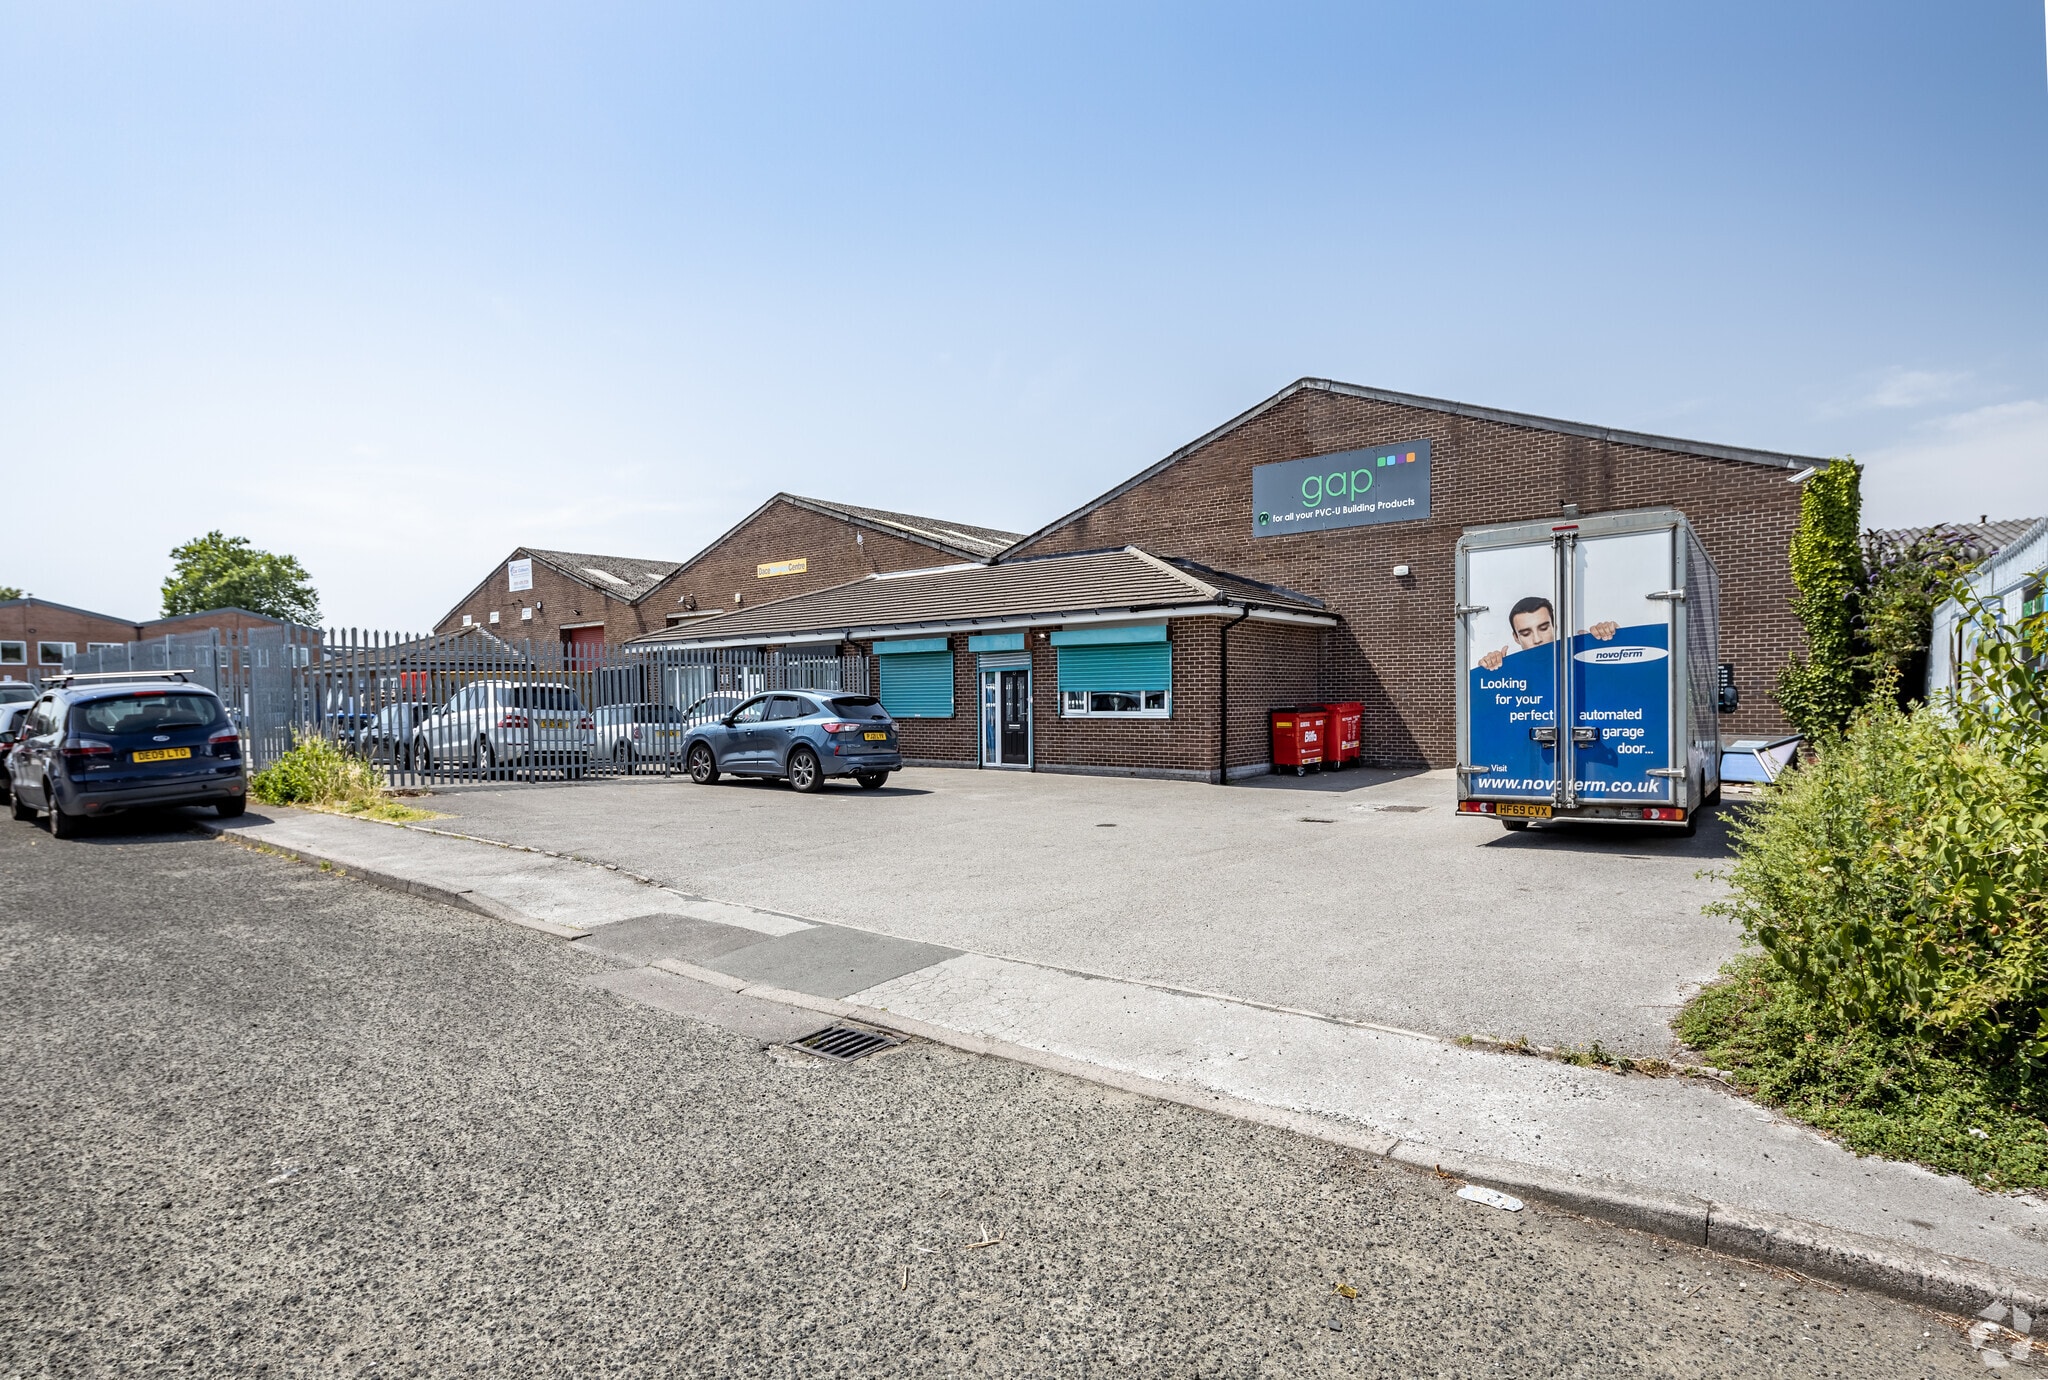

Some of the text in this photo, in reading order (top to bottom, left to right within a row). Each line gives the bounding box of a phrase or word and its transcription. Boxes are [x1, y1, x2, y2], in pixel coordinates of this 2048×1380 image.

[1301, 468, 1374, 508] gap
[1272, 497, 1416, 523] for all your PVC-U Building Products
[1595, 648, 1645, 662] novoferm
[1480, 677, 1527, 691] Looking
[1495, 693, 1544, 708] for your
[1509, 708, 1643, 724] perfect automated
[1602, 727, 1645, 740] garage
[1617, 742, 1654, 754] door...
[1490, 764, 1508, 772] Visit
[1499, 804, 1548, 816] HF69 CVX
